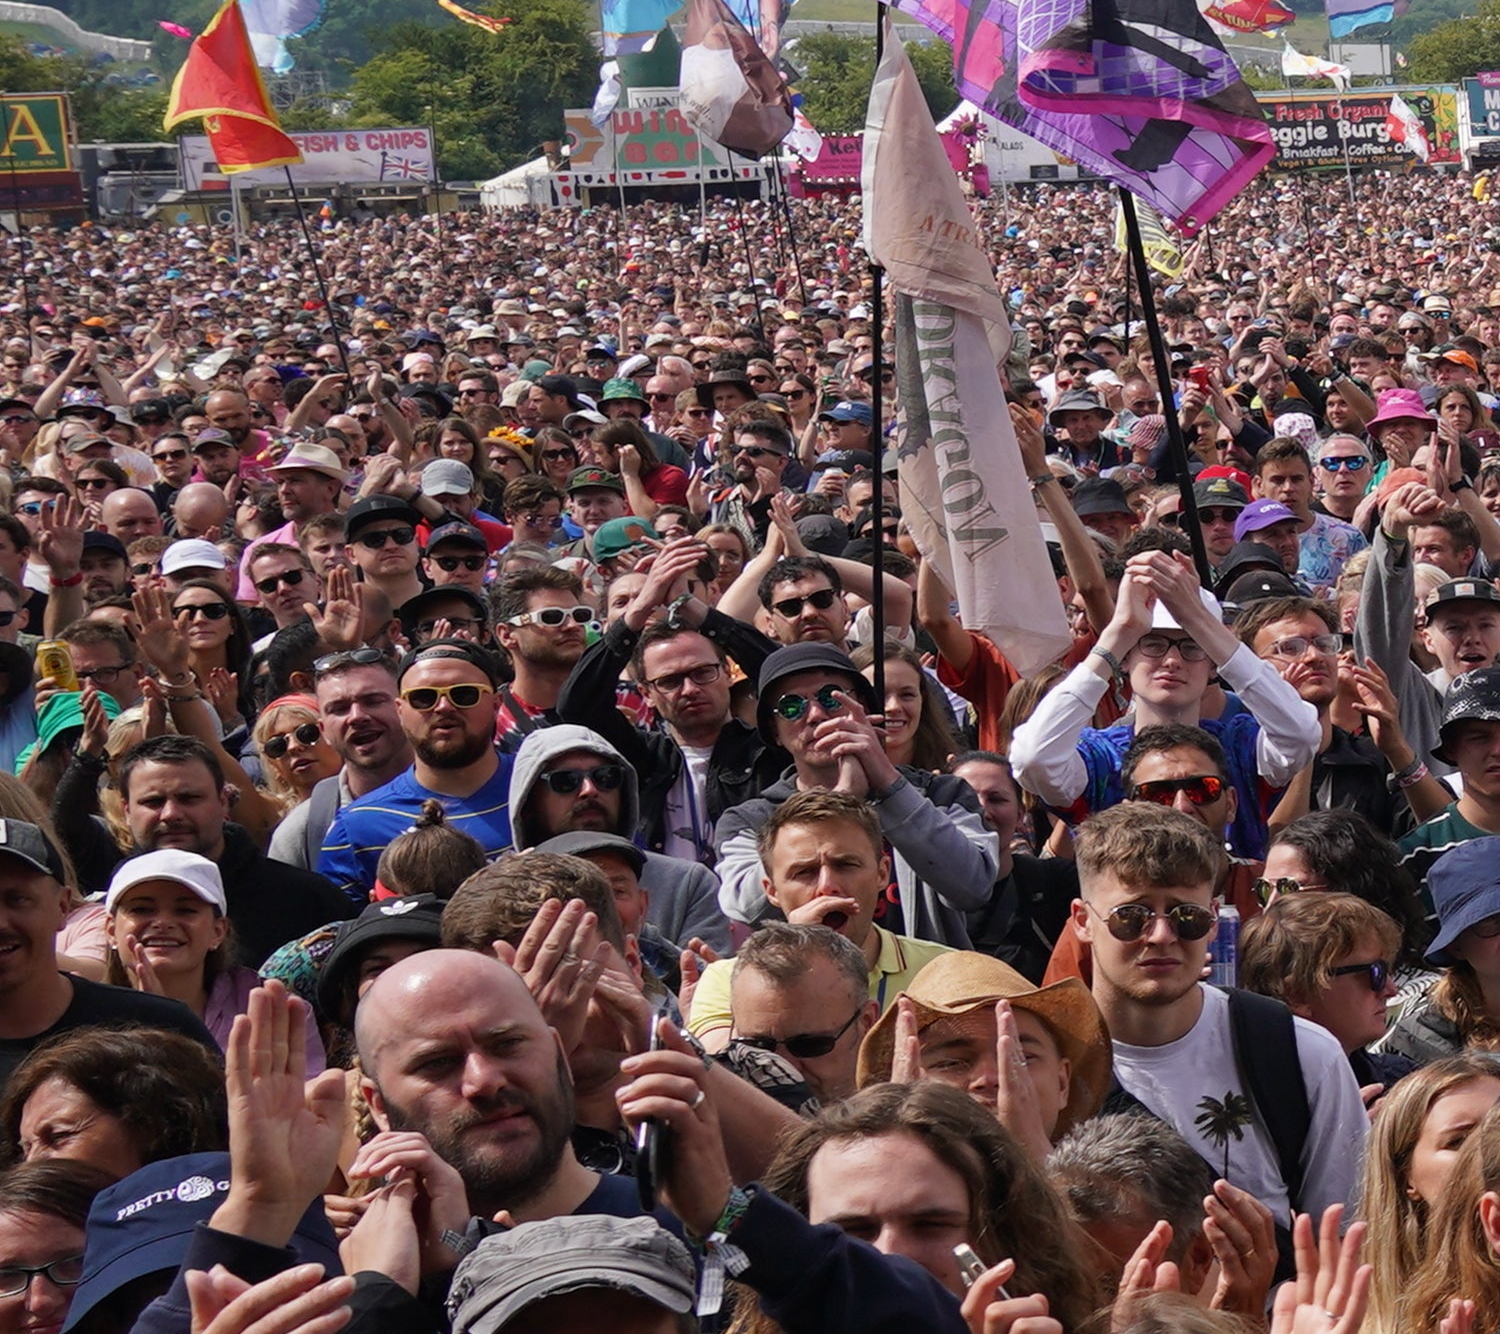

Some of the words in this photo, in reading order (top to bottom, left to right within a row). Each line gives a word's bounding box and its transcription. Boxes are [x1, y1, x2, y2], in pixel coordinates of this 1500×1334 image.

[1327, 101, 1390, 123] Organi
[298, 133, 338, 154] FISH
[365, 130, 428, 151] CHIPS
[1269, 124, 1328, 148] eggie
[1282, 145, 1339, 158] Breakfast
[117, 1187, 177, 1223] PRETTY
